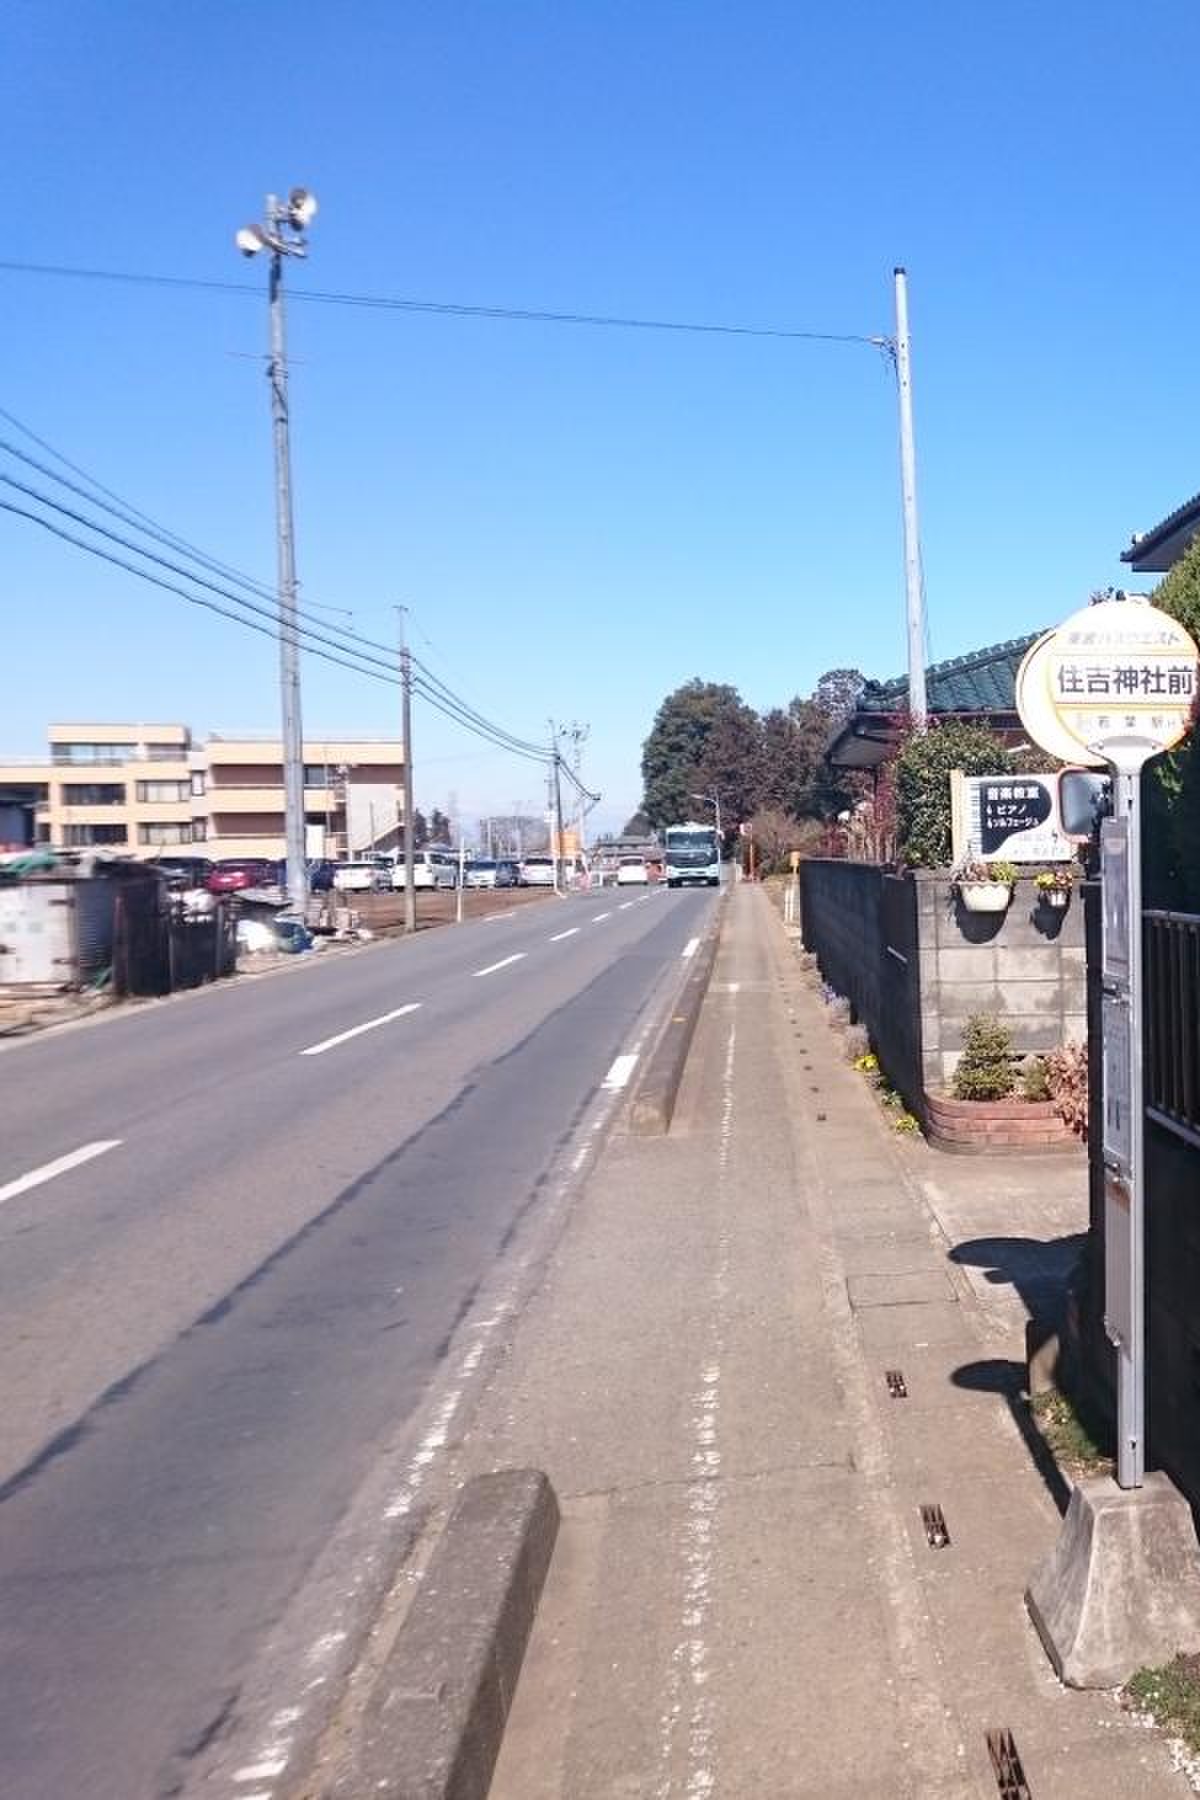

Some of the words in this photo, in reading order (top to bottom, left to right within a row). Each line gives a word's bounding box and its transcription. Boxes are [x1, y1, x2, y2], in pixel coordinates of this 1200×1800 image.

[1057, 664, 1193, 695] 住吉神社前
[996, 804, 1027, 815] ピアノ
